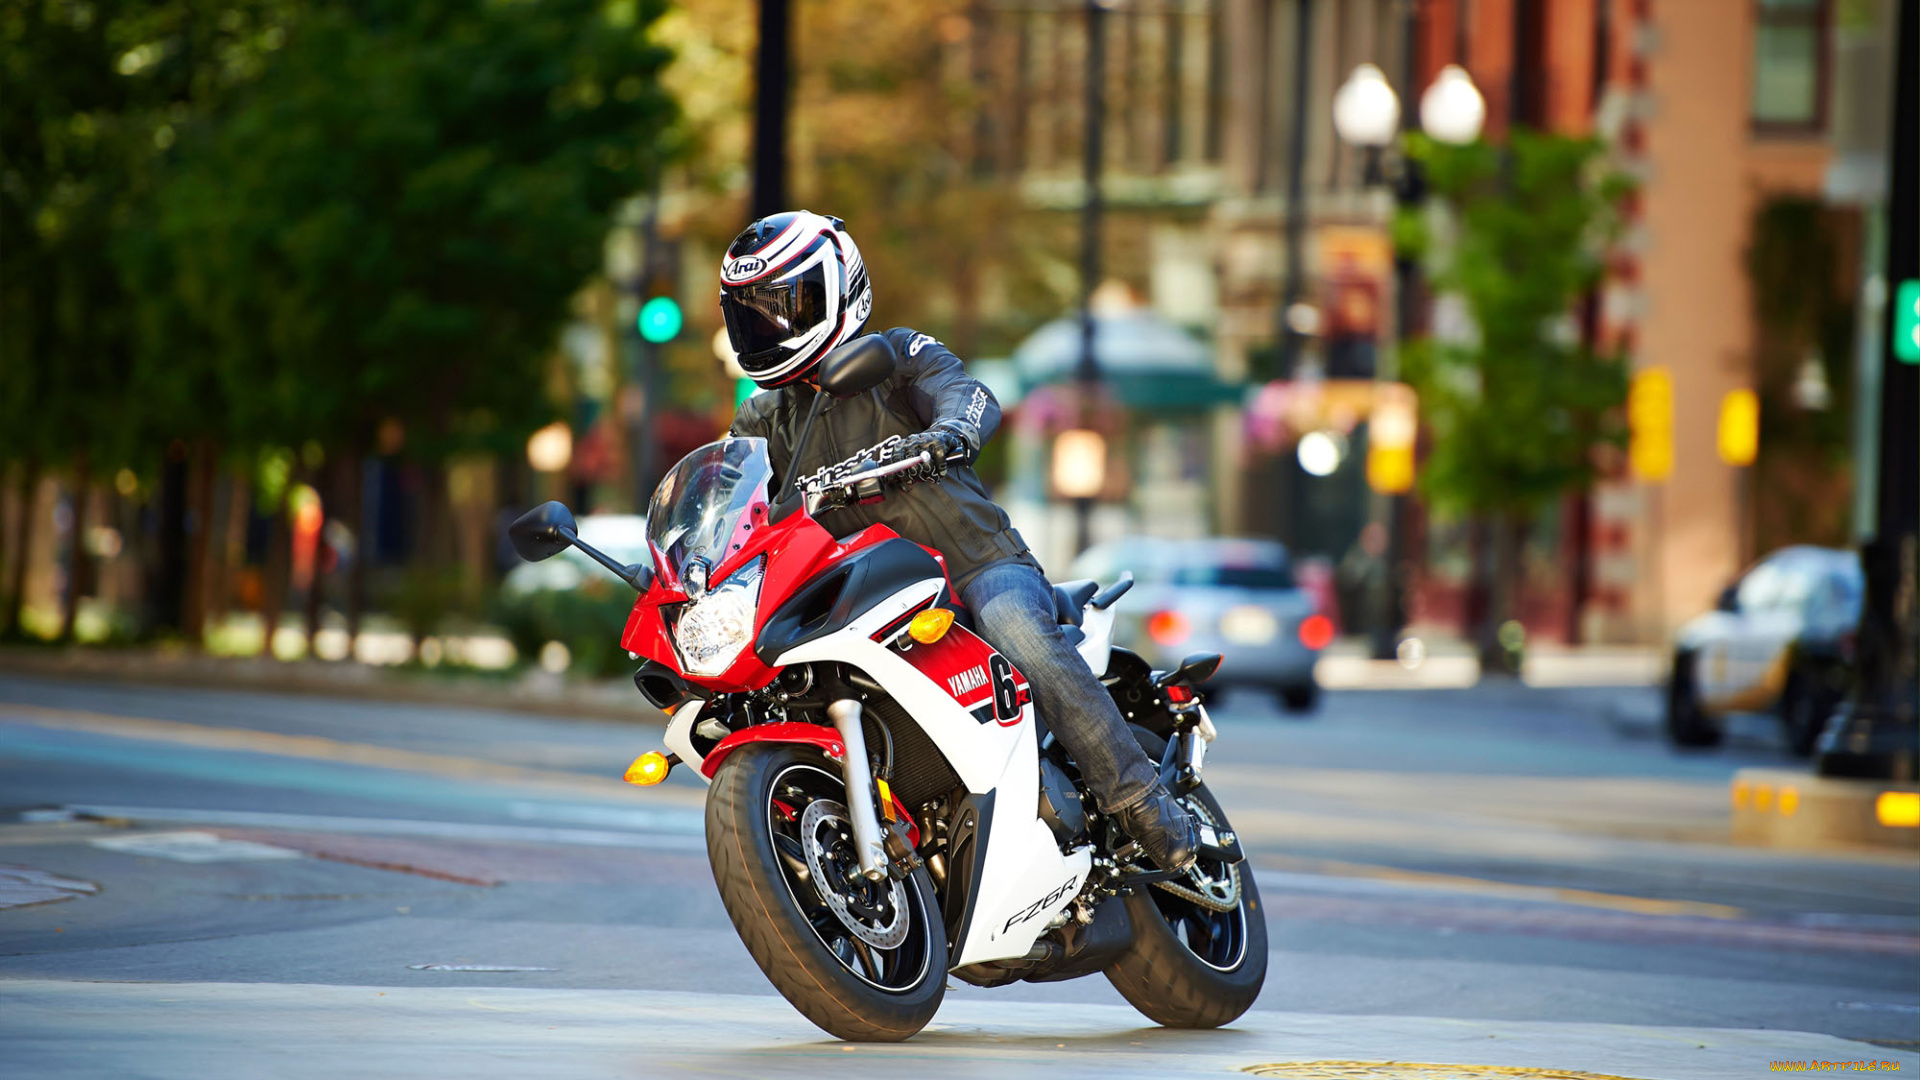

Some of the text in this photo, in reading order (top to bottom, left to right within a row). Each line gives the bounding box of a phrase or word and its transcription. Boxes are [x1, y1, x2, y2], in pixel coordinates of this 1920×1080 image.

[727, 258, 760, 276] Arai
[947, 664, 989, 697] YAMAHA
[1002, 875, 1077, 934] FZ6R
